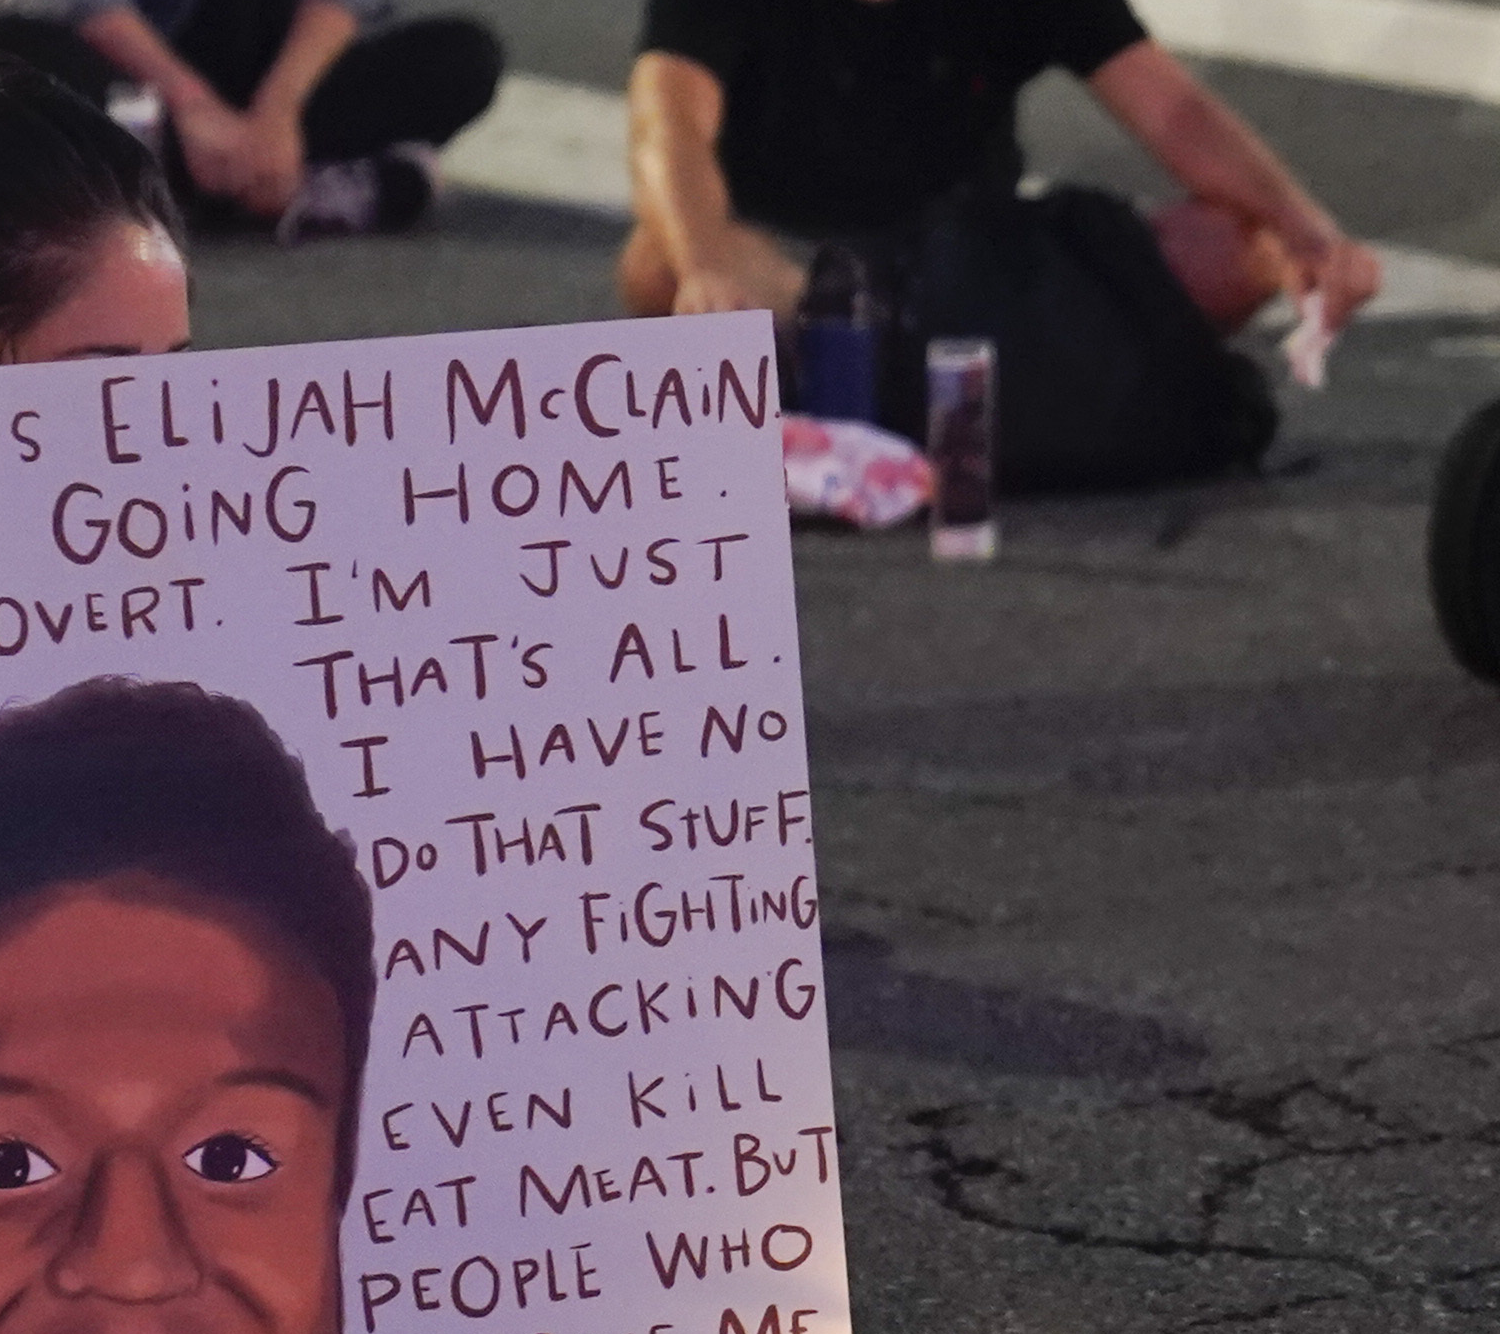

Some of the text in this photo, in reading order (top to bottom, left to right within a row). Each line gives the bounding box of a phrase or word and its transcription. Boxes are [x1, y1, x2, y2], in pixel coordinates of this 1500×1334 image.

[286, 561, 431, 626] I'M
[520, 533, 749, 598] JUST
[293, 634, 553, 720] THAT'S
[340, 736, 391, 798] I
[470, 711, 664, 780] HAVE
[700, 703, 787, 758] NO
[372, 837, 438, 890] DO
[445, 803, 602, 876] THAT
[384, 912, 547, 980] ANY
[382, 1088, 572, 1151] EVEN
[362, 1175, 476, 1244] EAT
[733, 1126, 833, 1197] BUT
[358, 1242, 601, 1334] PEOPLE
[645, 1224, 813, 1290] WHO
